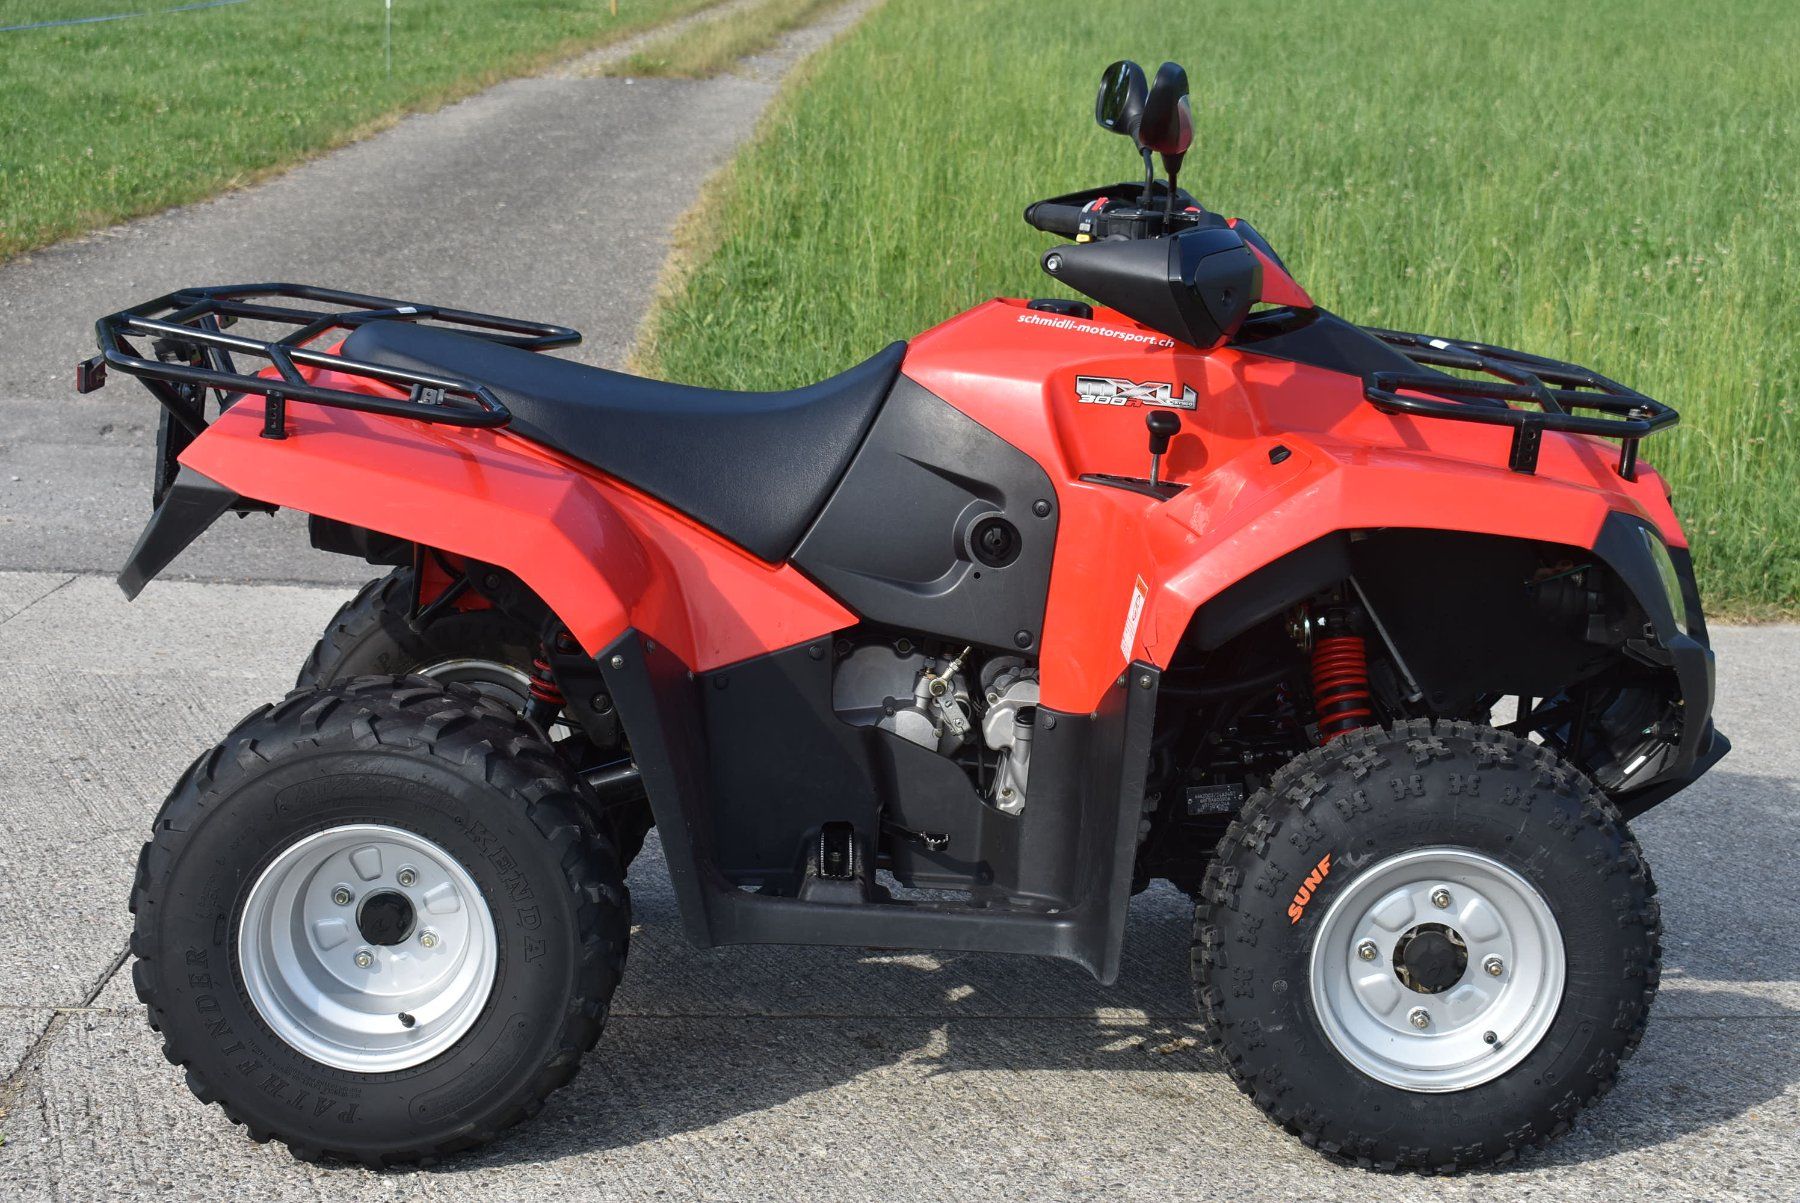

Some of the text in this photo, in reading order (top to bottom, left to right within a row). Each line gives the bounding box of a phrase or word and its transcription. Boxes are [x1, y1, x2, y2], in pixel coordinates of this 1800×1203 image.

[1018, 314, 1175, 347] schmidli-motorsport.ch
[1076, 375, 1199, 410] MXU
[464, 819, 546, 963] KENDA
[1287, 852, 1331, 925] SUNF
[184, 947, 361, 1125] PATHFINDER
